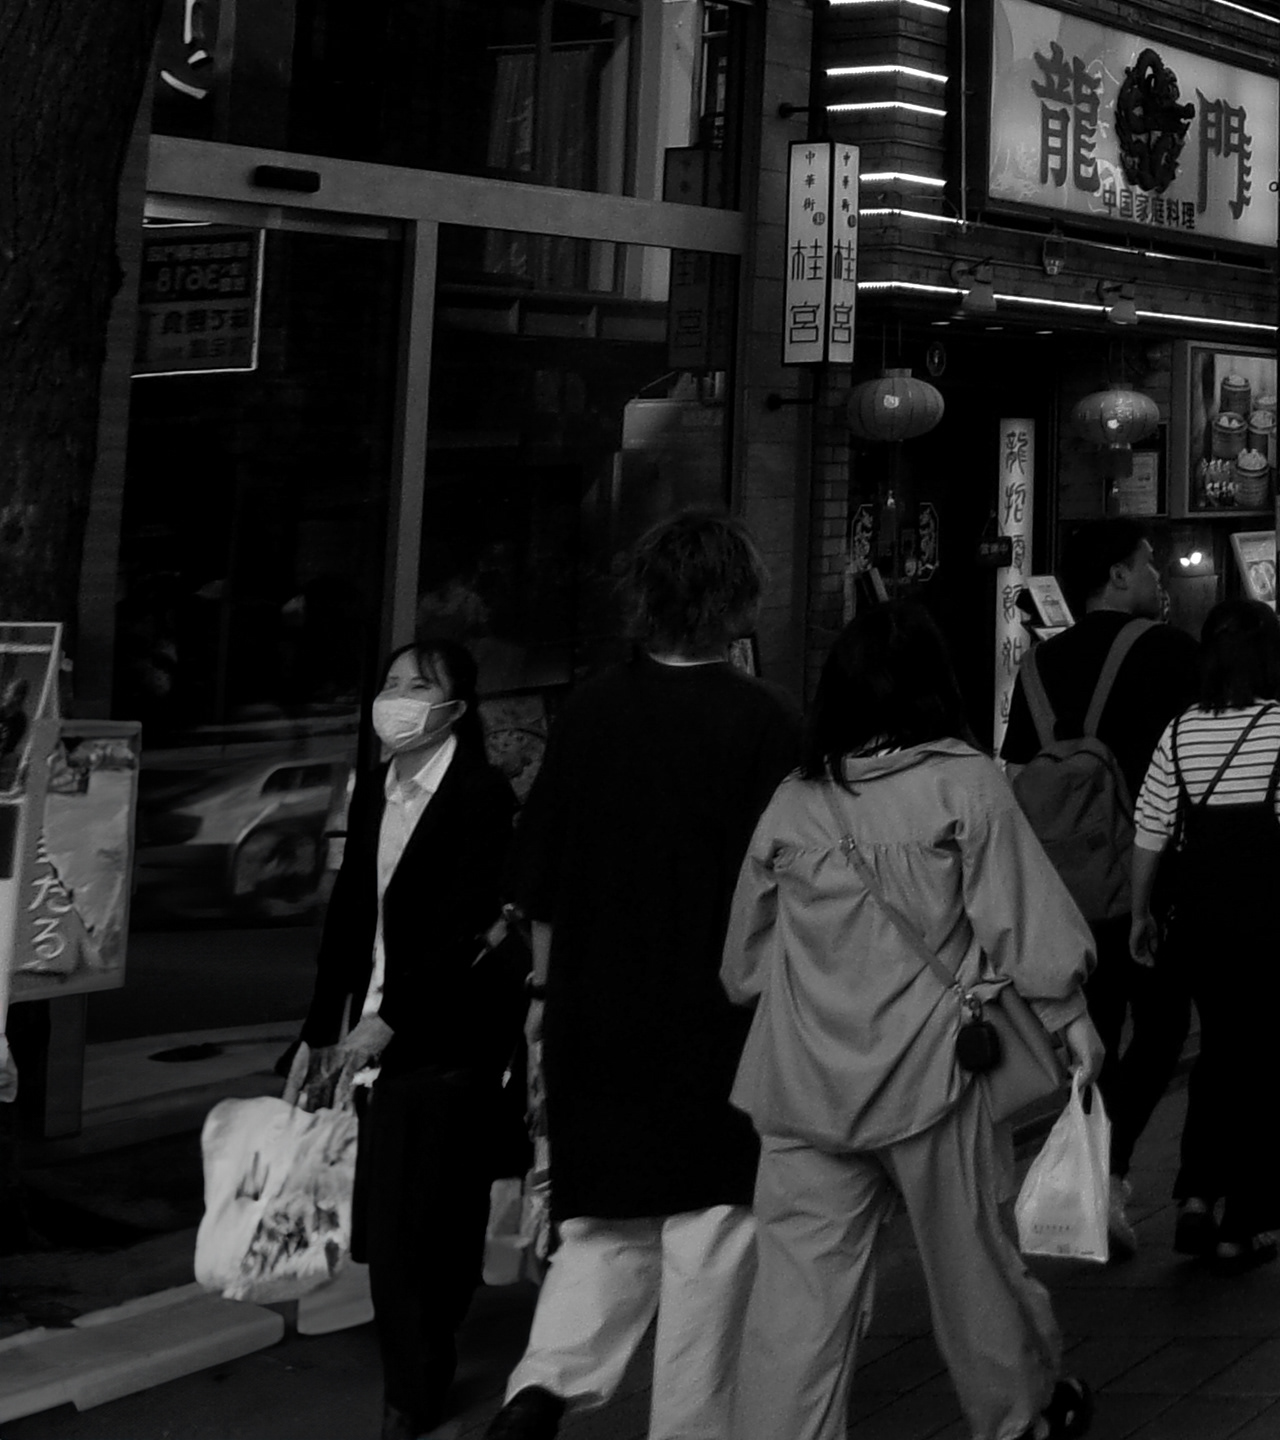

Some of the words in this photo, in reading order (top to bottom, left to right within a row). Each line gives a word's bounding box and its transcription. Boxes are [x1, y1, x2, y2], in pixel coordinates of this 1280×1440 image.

[1103, 189, 1195, 230] 中国家庭料理
[789, 238, 824, 345] 桂宮
